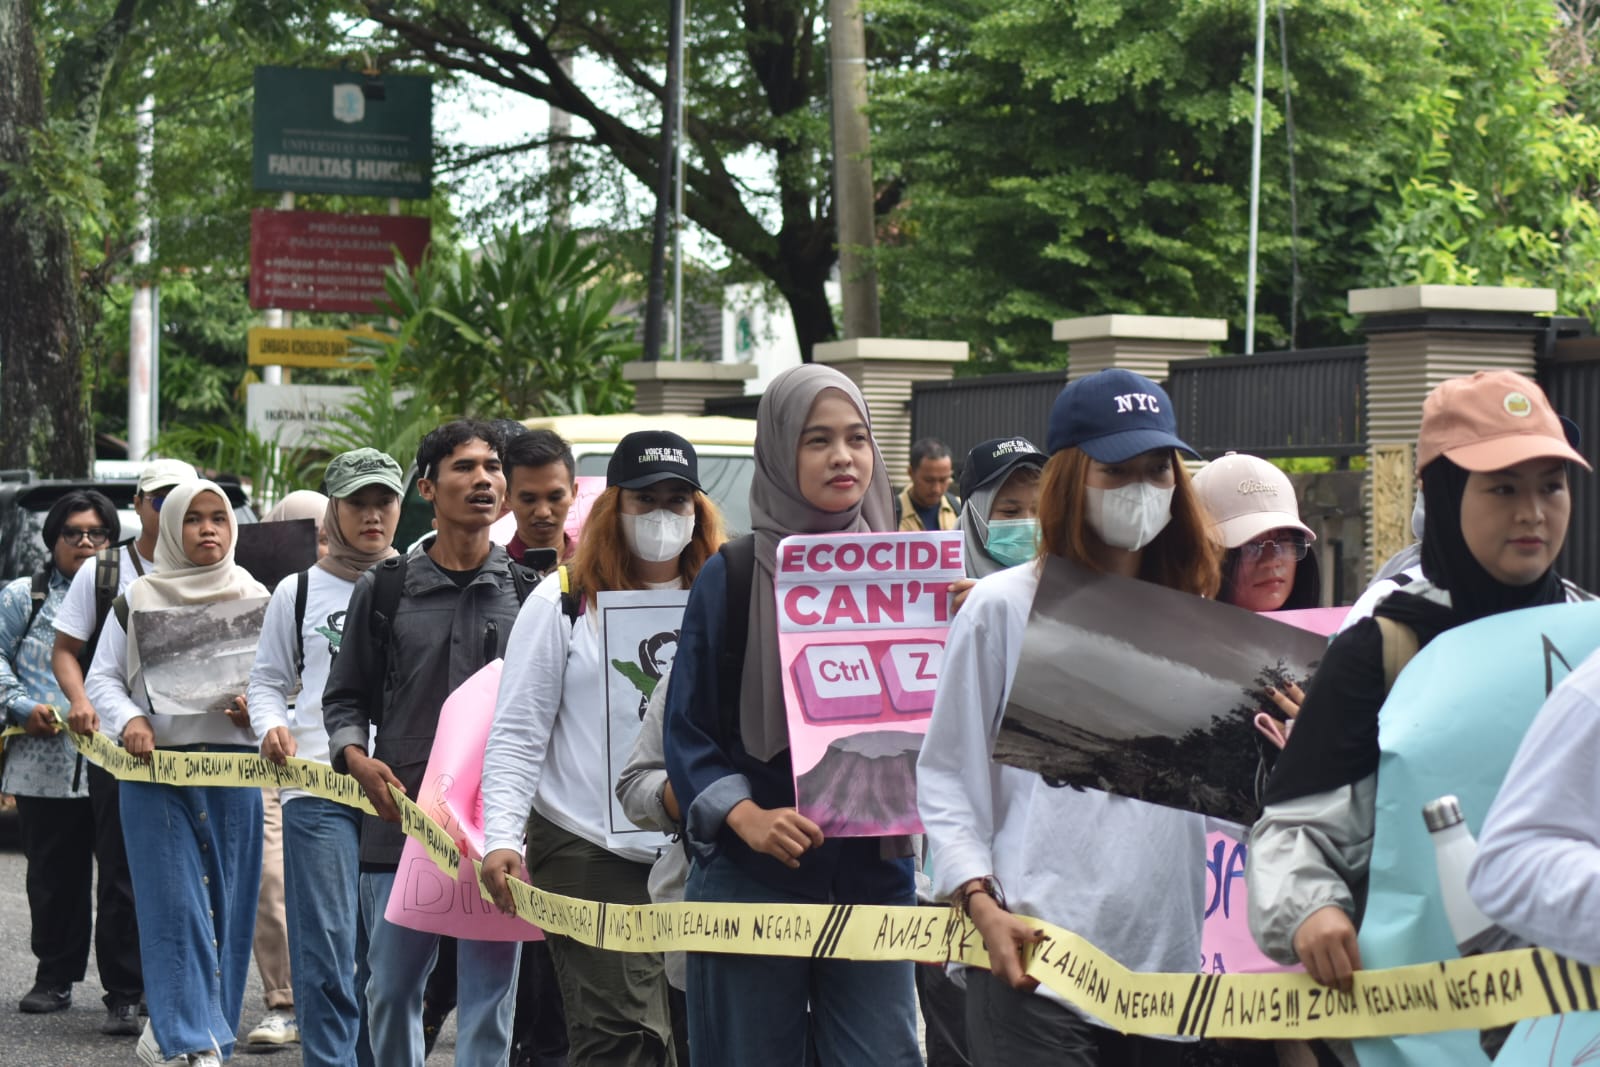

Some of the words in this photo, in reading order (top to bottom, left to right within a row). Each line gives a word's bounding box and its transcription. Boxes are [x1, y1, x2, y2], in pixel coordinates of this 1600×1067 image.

[268, 153, 352, 179] FAKULTAS
[1113, 392, 1160, 414] NYC
[638, 455, 659, 464] EARTH
[644, 447, 662, 456] VOICE
[663, 447, 671, 456] OF
[672, 448, 683, 458] THE
[992, 447, 1013, 459] EARTH
[996, 440, 1016, 451] VOICE
[781, 540, 963, 573] ECOCIDE
[783, 580, 954, 627] CAN'T
[819, 658, 871, 684] Ctrl
[908, 652, 938, 681] Z
[649, 910, 674, 941] ZONA
[752, 914, 812, 941] NEGARA
[1114, 989, 1174, 1019] NEGARA
[1307, 987, 1359, 1021] ZONA
[1445, 967, 1523, 1011] NEGARA
